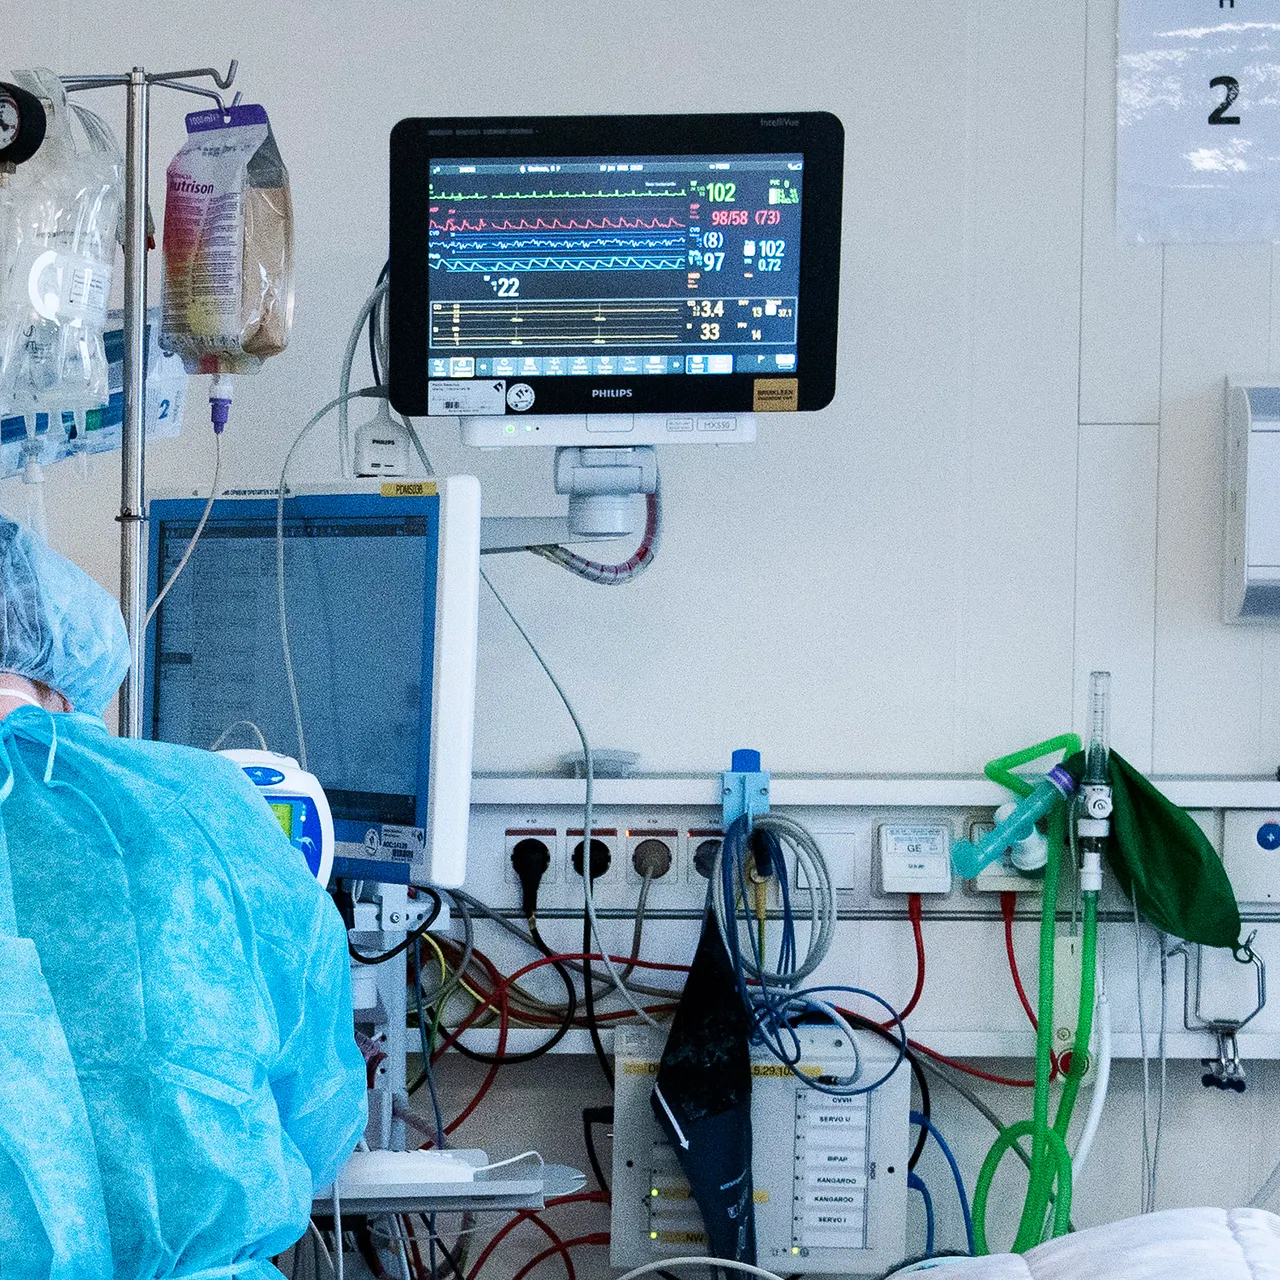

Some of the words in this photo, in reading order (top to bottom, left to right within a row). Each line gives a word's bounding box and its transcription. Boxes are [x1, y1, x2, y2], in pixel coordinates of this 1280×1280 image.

[1208, 76, 1240, 125] 2
[706, 182, 736, 202] 102
[711, 211, 749, 226] 98/58
[754, 210, 781, 225] (73)
[703, 231, 724, 248] (8)
[759, 240, 785, 257] 102
[703, 252, 725, 271] 97
[758, 259, 781, 271] 0.72
[498, 278, 519, 297] 22
[701, 300, 724, 317] 3.4
[700, 323, 720, 340] 33
[592, 389, 633, 397] PHILIPS
[907, 845, 921, 853] GE
